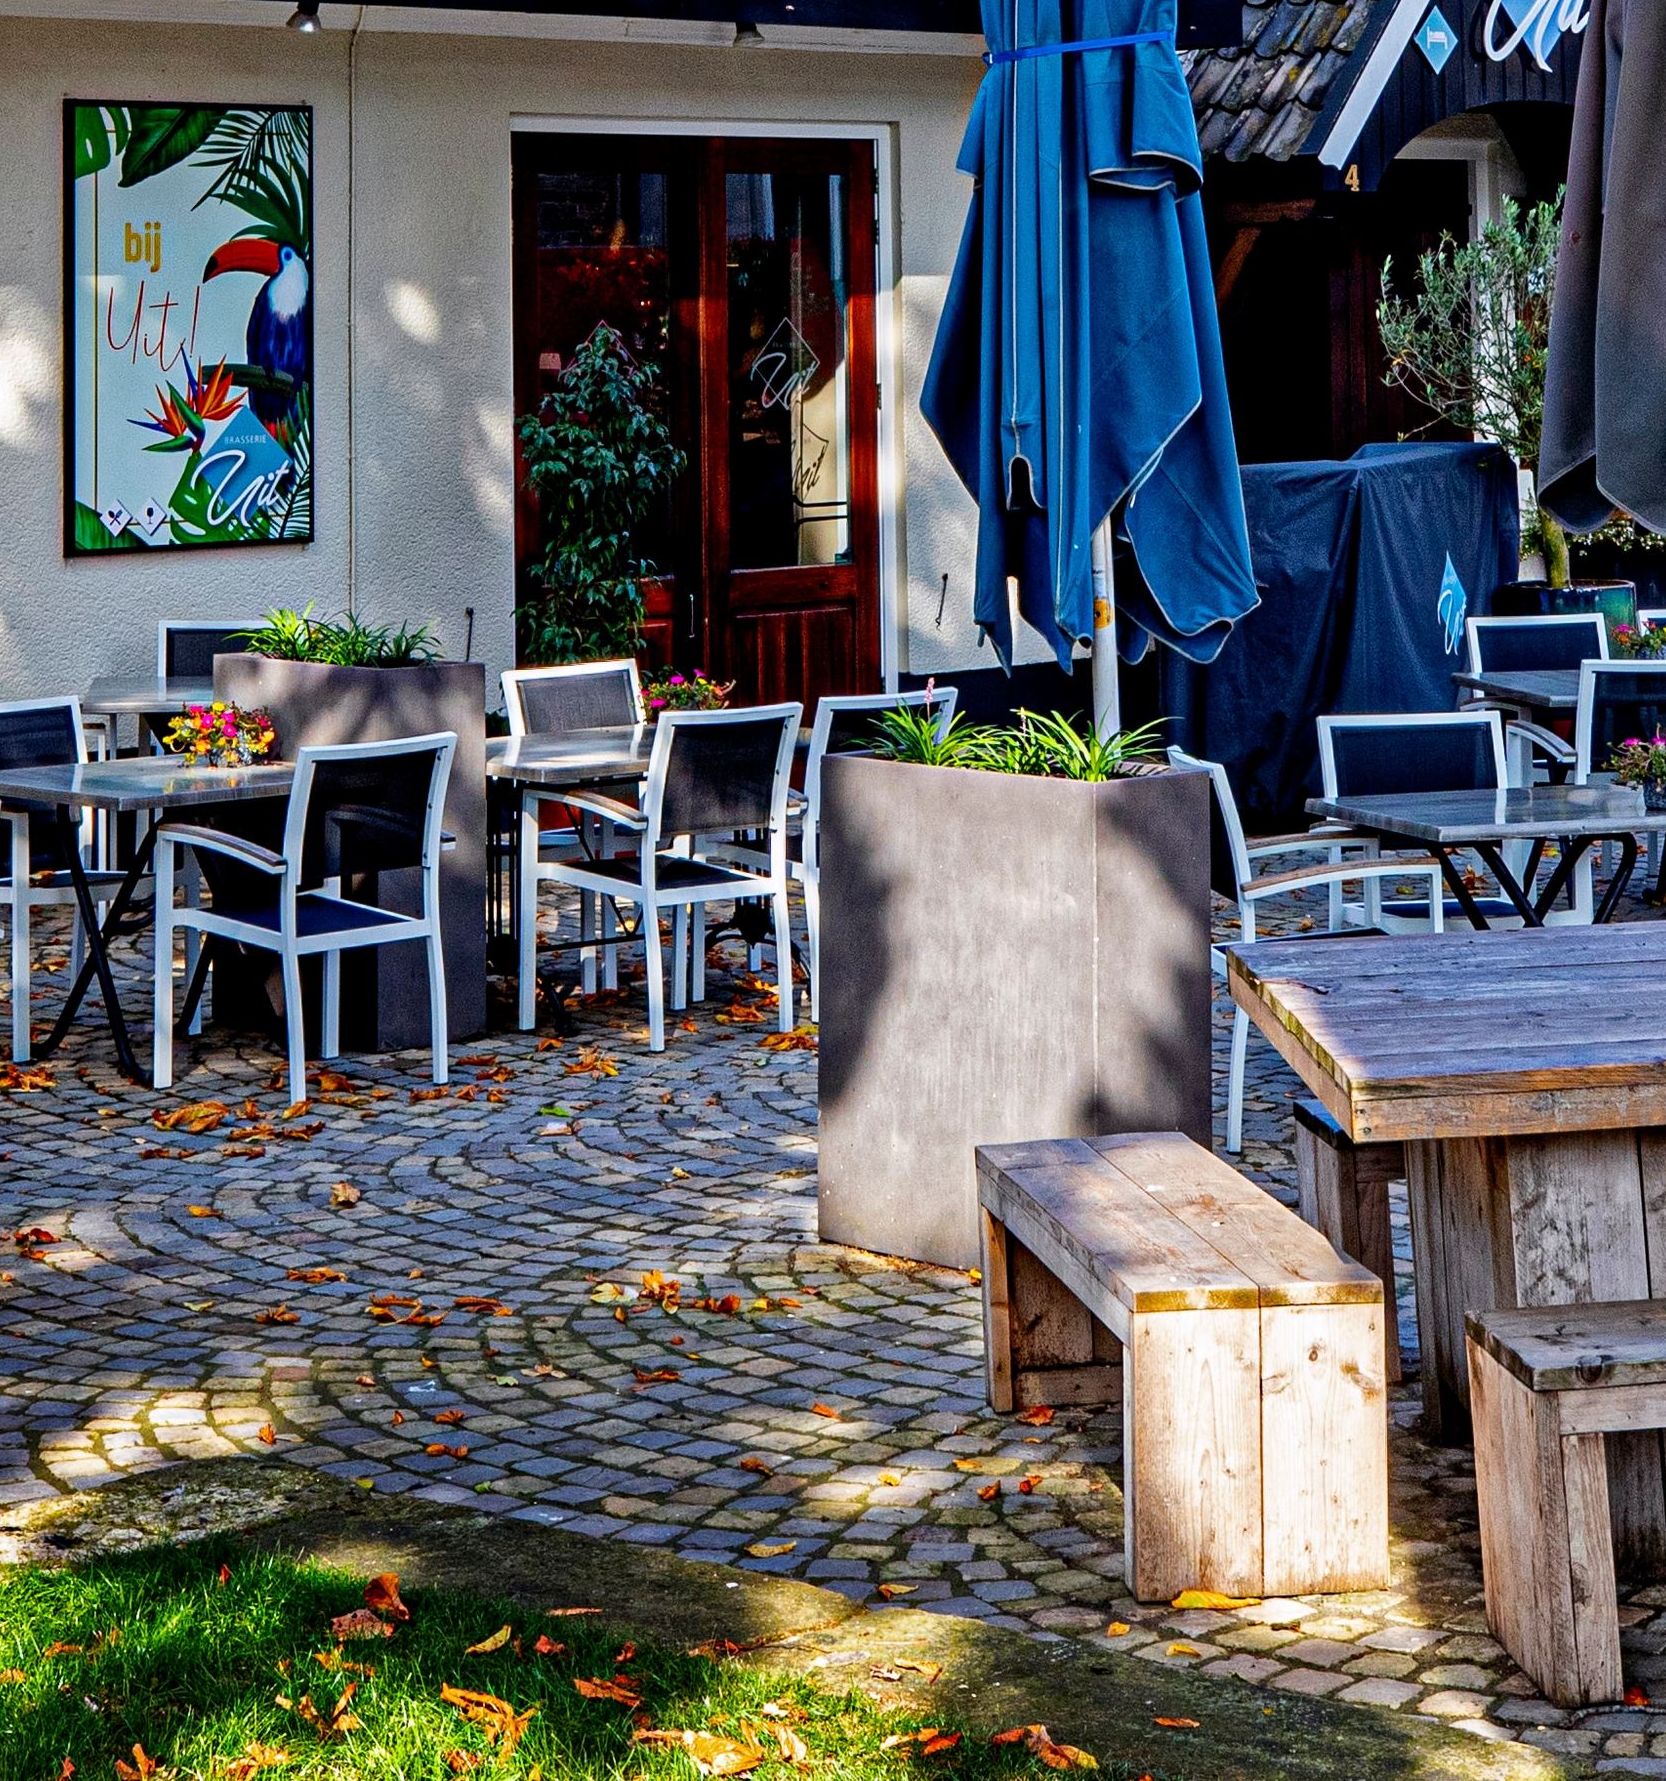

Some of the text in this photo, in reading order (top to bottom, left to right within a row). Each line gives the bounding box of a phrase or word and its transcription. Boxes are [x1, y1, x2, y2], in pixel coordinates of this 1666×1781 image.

[1344, 164, 1360, 192] 4
[123, 221, 162, 273] bij
[224, 434, 268, 445] BRASSERIE
[190, 448, 290, 528] Uit
